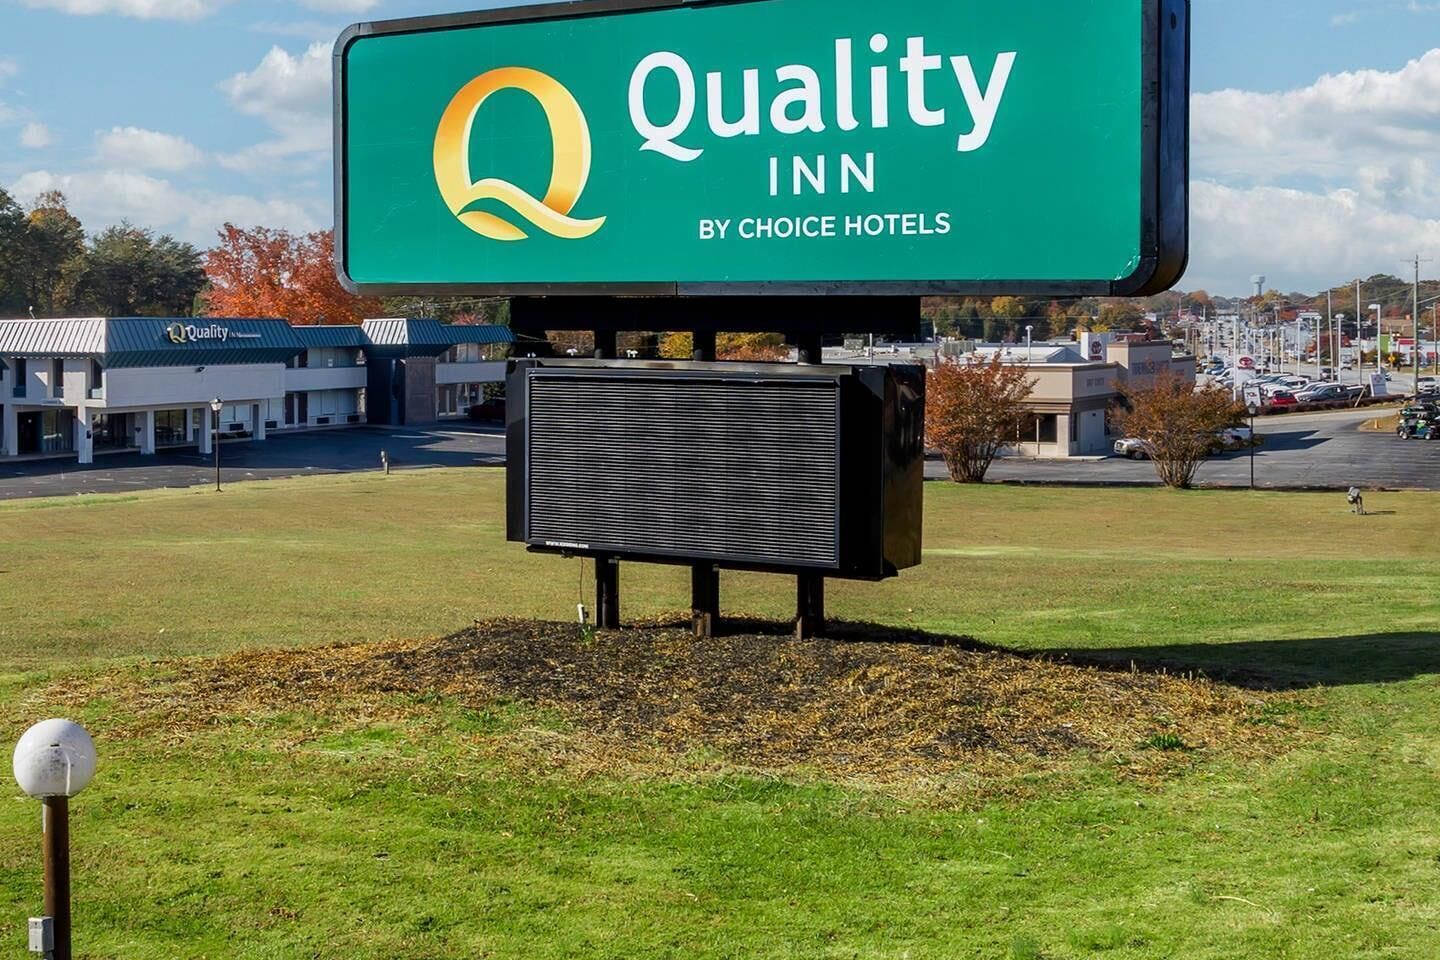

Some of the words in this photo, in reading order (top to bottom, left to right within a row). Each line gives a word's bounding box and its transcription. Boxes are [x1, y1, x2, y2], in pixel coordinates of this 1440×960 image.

[629, 33, 1017, 161] Quality
[432, 66, 607, 241] Q
[769, 152, 874, 196] INN
[699, 219, 731, 240] BY
[738, 215, 836, 239] CHOICE
[844, 212, 951, 236] HOTELS
[187, 324, 228, 342] Quality
